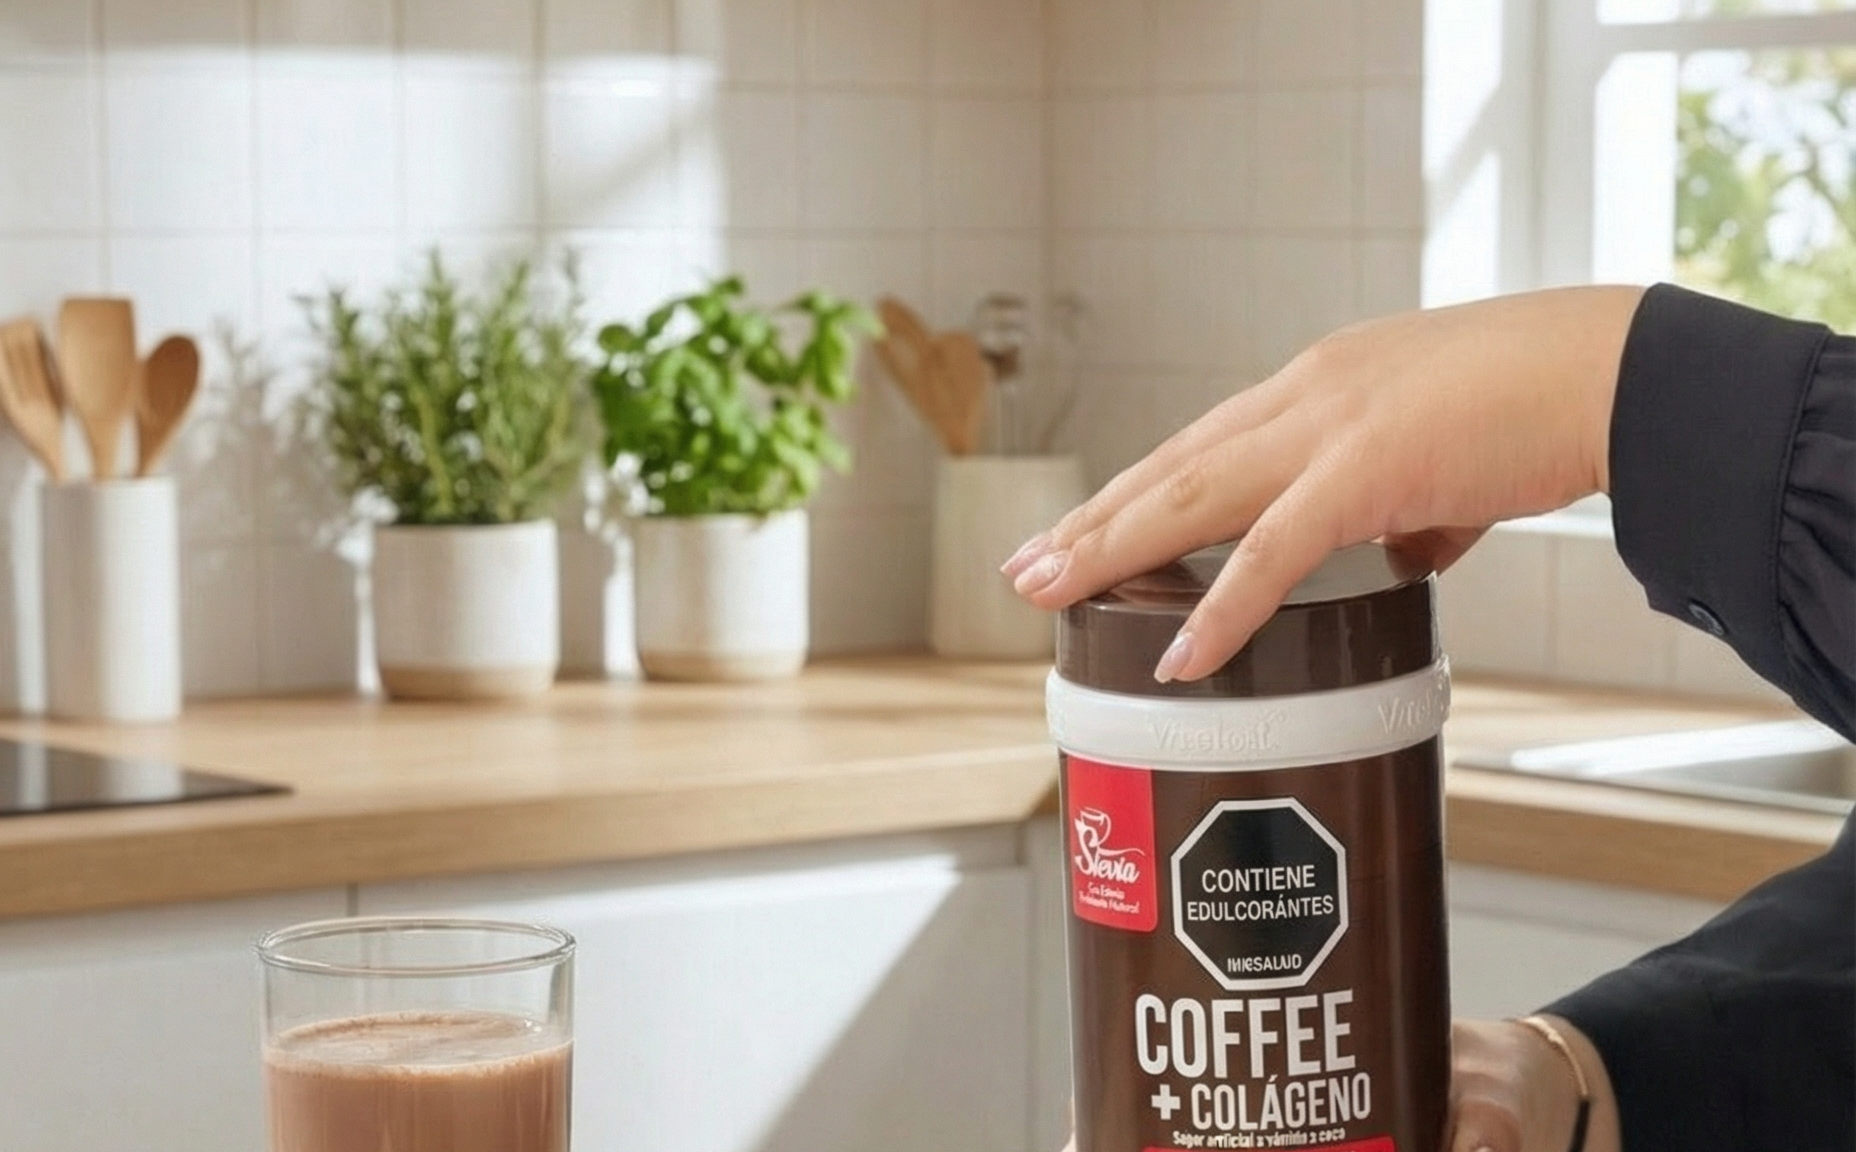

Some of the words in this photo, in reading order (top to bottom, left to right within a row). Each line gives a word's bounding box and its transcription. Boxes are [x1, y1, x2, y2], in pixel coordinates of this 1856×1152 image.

[1202, 864, 1316, 893] CONTIENE
[1187, 894, 1334, 921] EDULCORÁNTES
[1135, 988, 1356, 1079] COFFEE
[1191, 1072, 1371, 1131] COLÁGENO
